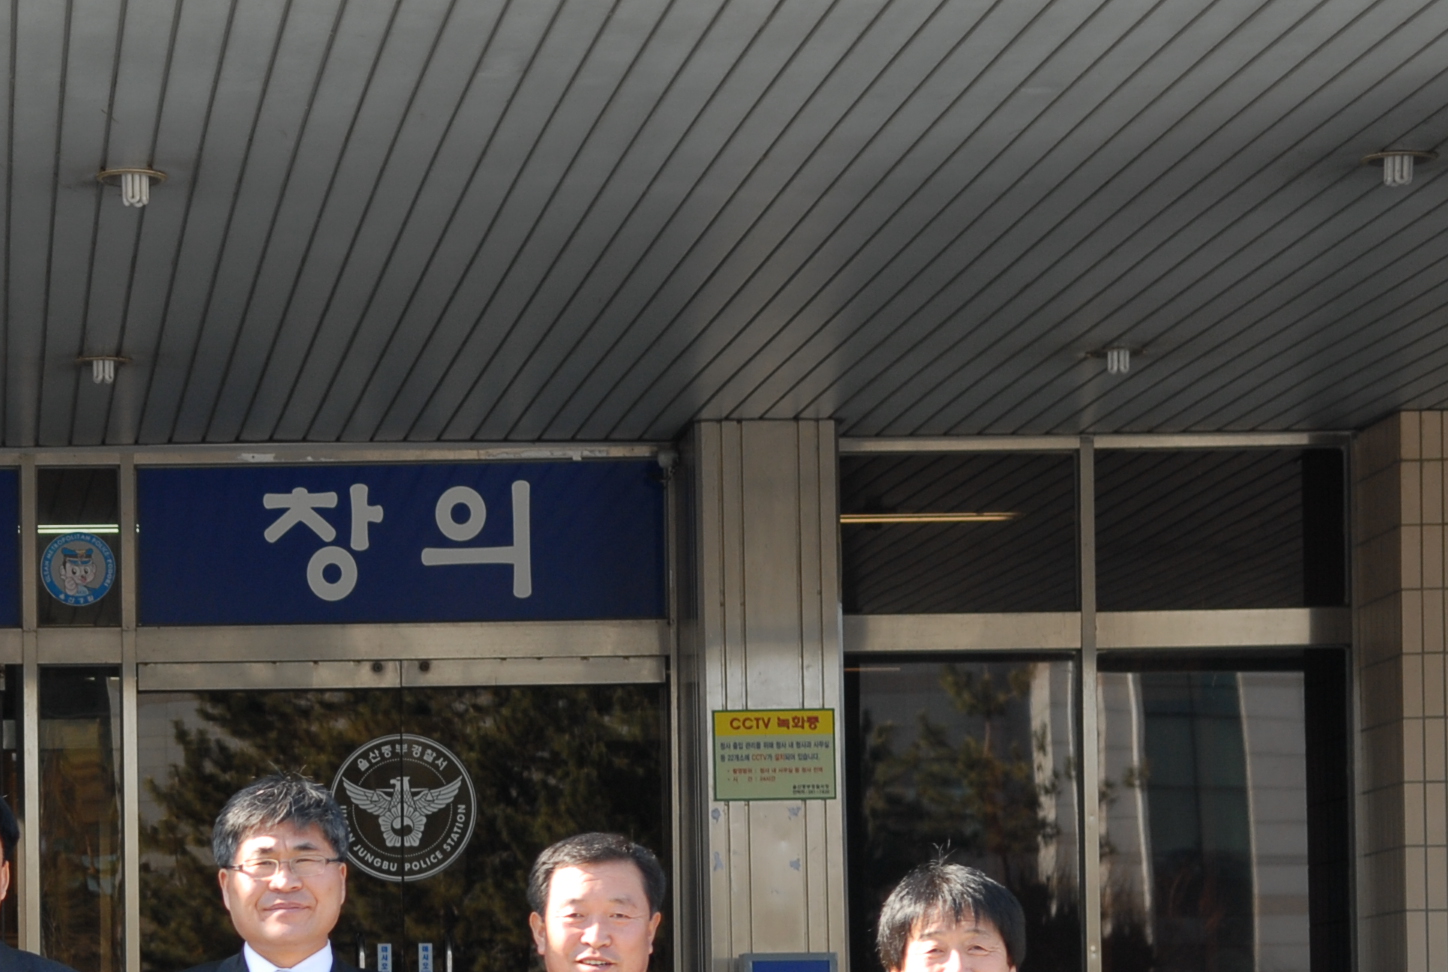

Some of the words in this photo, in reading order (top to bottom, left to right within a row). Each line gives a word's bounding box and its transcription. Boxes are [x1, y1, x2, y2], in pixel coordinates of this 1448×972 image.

[263, 479, 532, 601] 창의
[729, 717, 771, 730] CCTV
[777, 715, 820, 731] 녹화중
[357, 743, 448, 772] 울산중부경찰서
[353, 843, 398, 872] JUNGBU
[404, 850, 444, 872] POLICE
[443, 804, 467, 853] STATION
